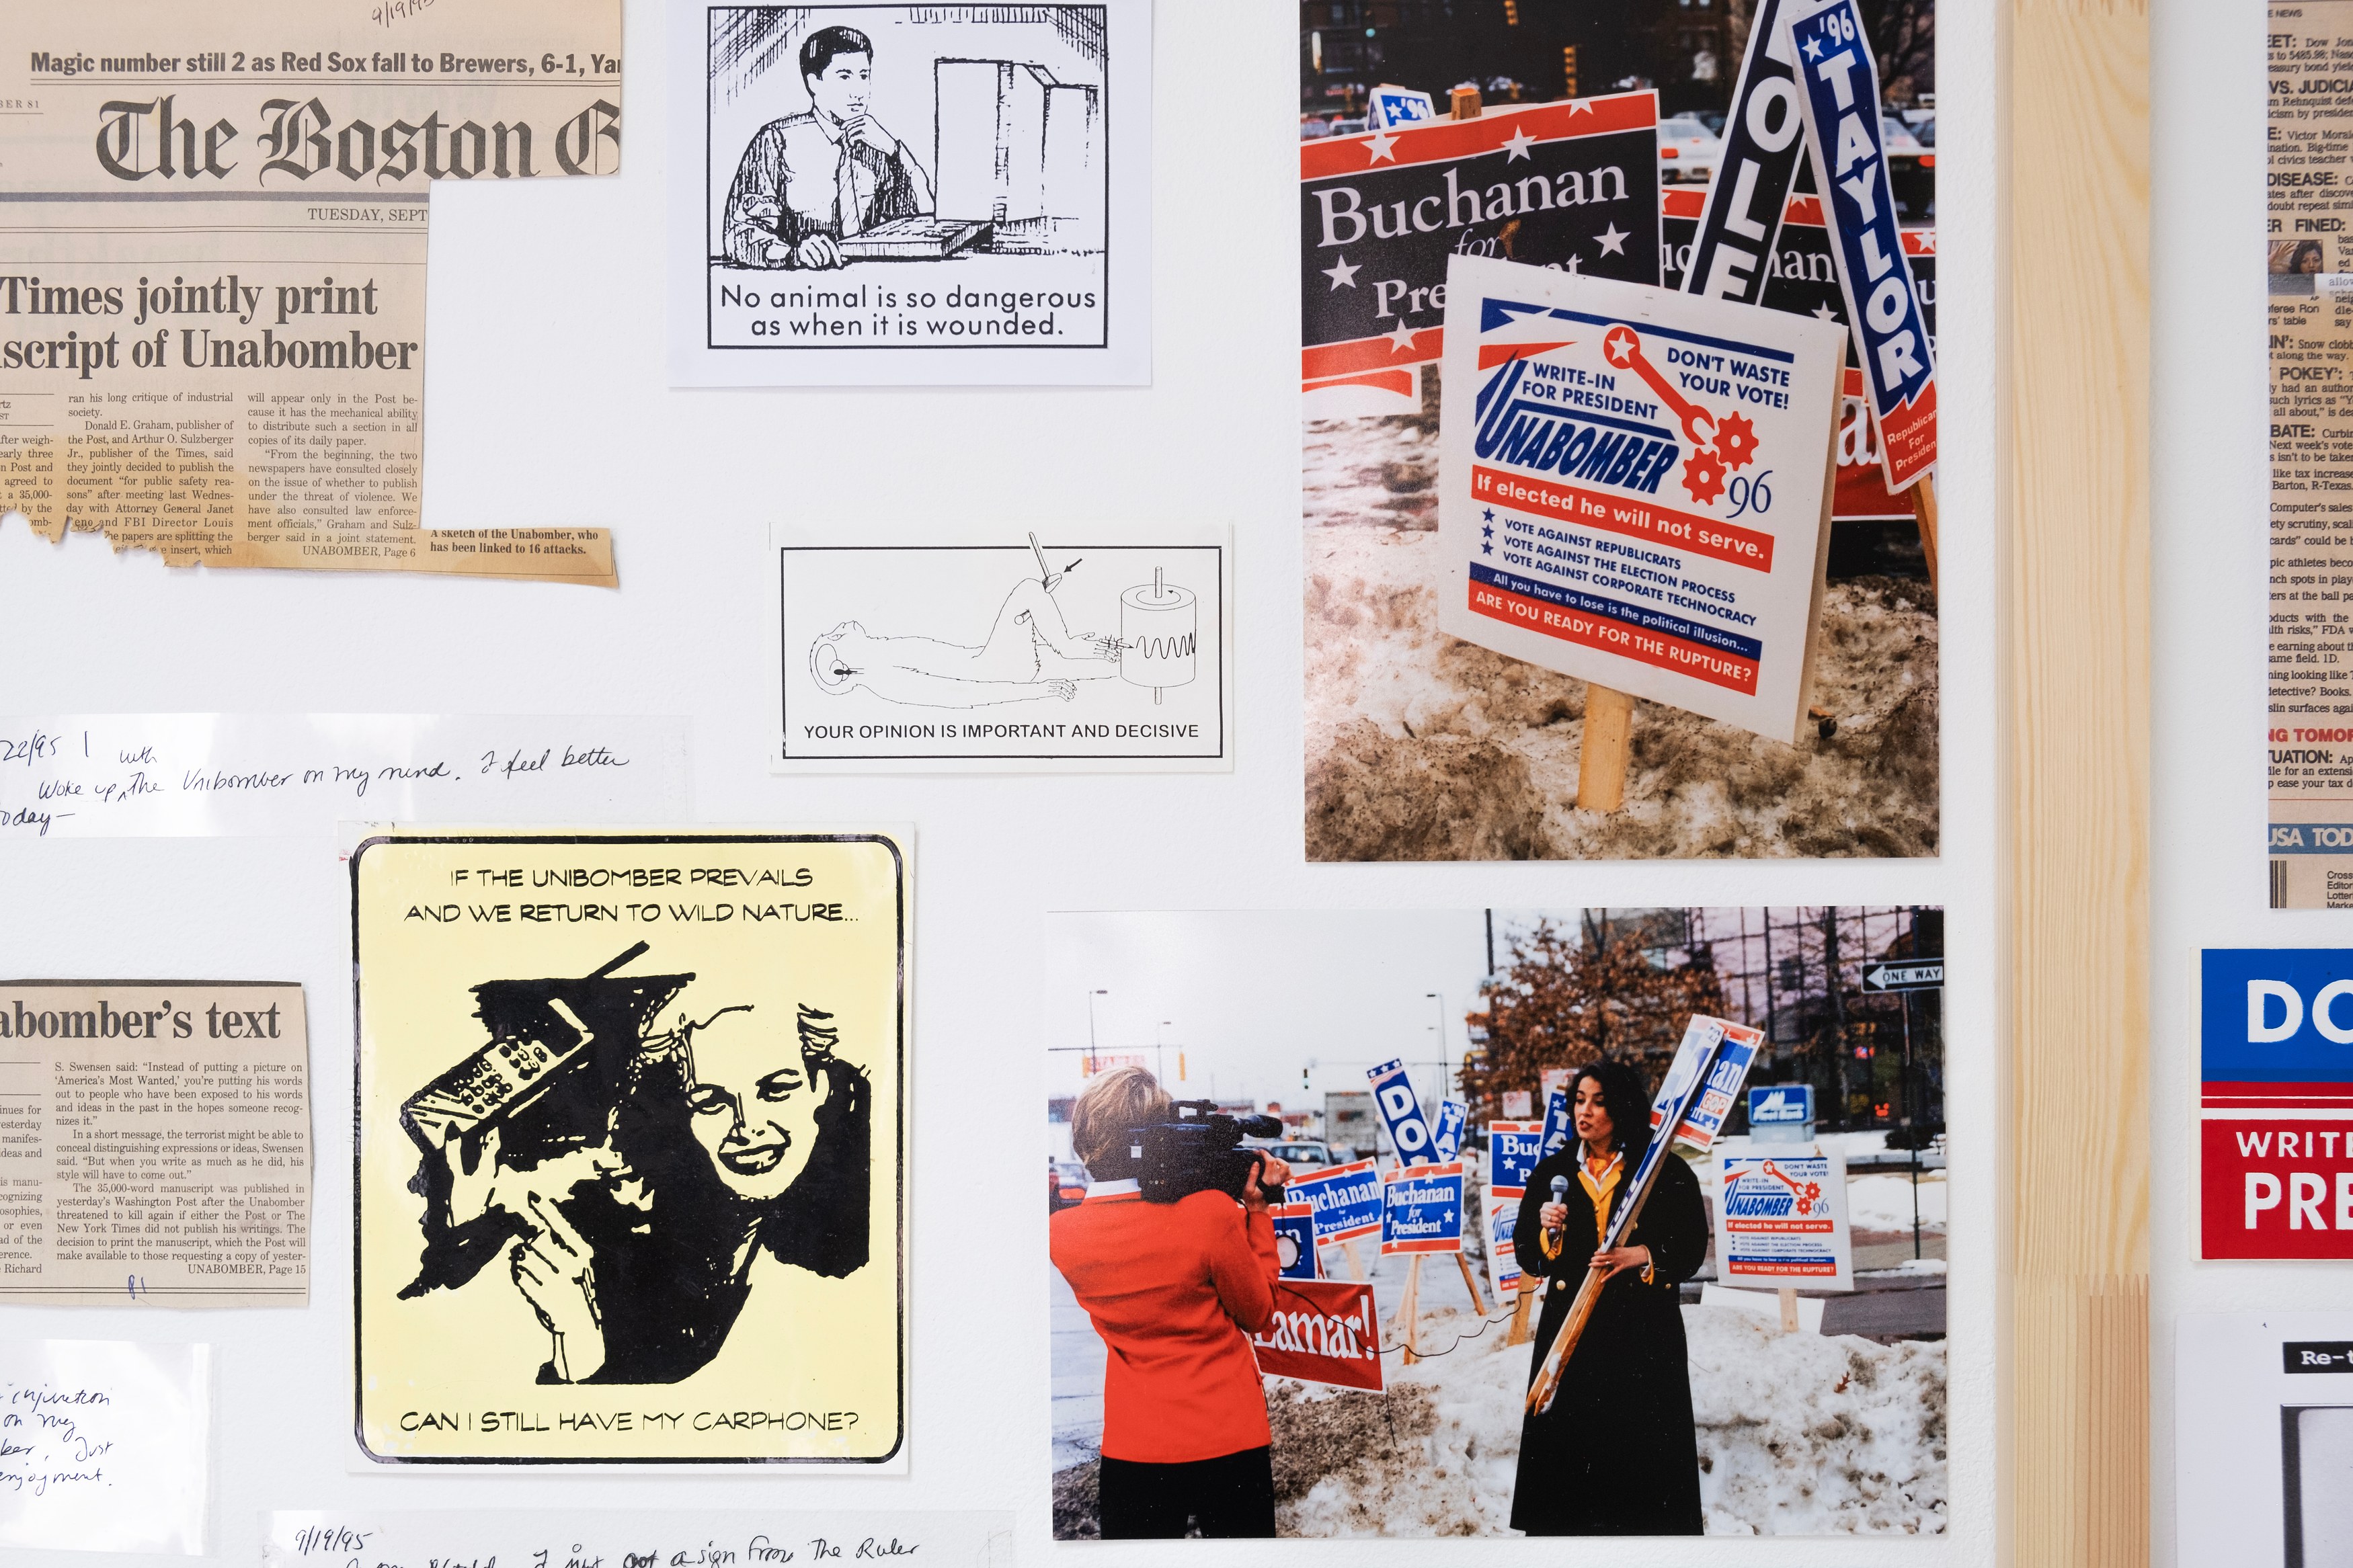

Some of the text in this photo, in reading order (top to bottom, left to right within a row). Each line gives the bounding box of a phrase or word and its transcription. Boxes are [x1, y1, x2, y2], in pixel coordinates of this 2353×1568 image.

[31, 51, 621, 77] Magic number still 2 as Red Sox fall to Brewers, 6-1, Ya
[95, 94, 541, 187] The Boston
[2268, 172, 2338, 186] DISEASE:
[307, 208, 383, 222] TUESDAY,
[1312, 165, 1629, 248] Buchanan
[1817, 48, 1923, 392] TAYLOR
[2295, 218, 2346, 233] FINED:
[1, 275, 378, 324] Times jointly print
[721, 284, 1094, 313] No animal is so dangerous
[752, 313, 1062, 335] as when it is wounded.
[0, 329, 417, 379] script of Unabomber
[1667, 347, 1790, 386] DON'T WASTE
[1533, 362, 1615, 390] WRITE-IN
[1679, 372, 1788, 409] YOUR VOTE!
[247, 393, 417, 405] will appear only in the Post be-
[1522, 380, 1658, 419] FOR PRESIDENT
[1474, 359, 1773, 519] UNABOMBER 96
[1477, 473, 1763, 558] If elected he will not serve.
[430, 542, 586, 554] has been linked to 16 attacks.
[441, 530, 475, 538] sketch
[478, 529, 488, 538] of
[491, 529, 507, 538] the
[511, 529, 574, 541] Unabomber,
[577, 530, 598, 540] who
[1505, 518, 1680, 569] VOTE AGAINST REPUBLICRATS
[303, 545, 415, 559] UNABOMBER, Page 6
[1504, 535, 1734, 603] VOTE AGAINST THE ELECTION PROCESS
[1503, 550, 1756, 626] VOTE AGAINST CORPORATE TECHNOCRACY
[1493, 573, 1507, 585] All
[1511, 580, 1530, 591] you
[1533, 583, 1561, 600] have
[1565, 593, 1577, 604] to
[1580, 595, 1603, 610] lose
[1608, 602, 1617, 614] is
[1621, 606, 1638, 620] the
[1642, 615, 1689, 634] political
[1476, 591, 1751, 681] ARE YOU READY FOR THE RUPTURE?
[804, 724, 1198, 738] YOUR OPINION IS IMPORTANT AND DECISIVE
[561, 745, 630, 767] better
[450, 868, 813, 887] IF THE UNIBOMBER PREVAILS
[404, 903, 859, 922] AND WE RETURN TO WILD NATURE...
[1883, 968, 1940, 981] ONE WAY
[205, 1001, 280, 1038] text
[1386, 1185, 1455, 1208] Buchanan
[1726, 1178, 1829, 1219] UNABOMBER 96
[2245, 1172, 2353, 1230] PRE
[1390, 1216, 1442, 1235] President
[188, 1264, 305, 1276] UNABOMBER, Page 15
[400, 1411, 458, 1431] CAN
[481, 1411, 549, 1432] STILL
[559, 1412, 632, 1431] HAVE
[643, 1412, 684, 1429] MY
[692, 1411, 859, 1430] CARPHONE?
[295, 1525, 373, 1556] 9/19/95
